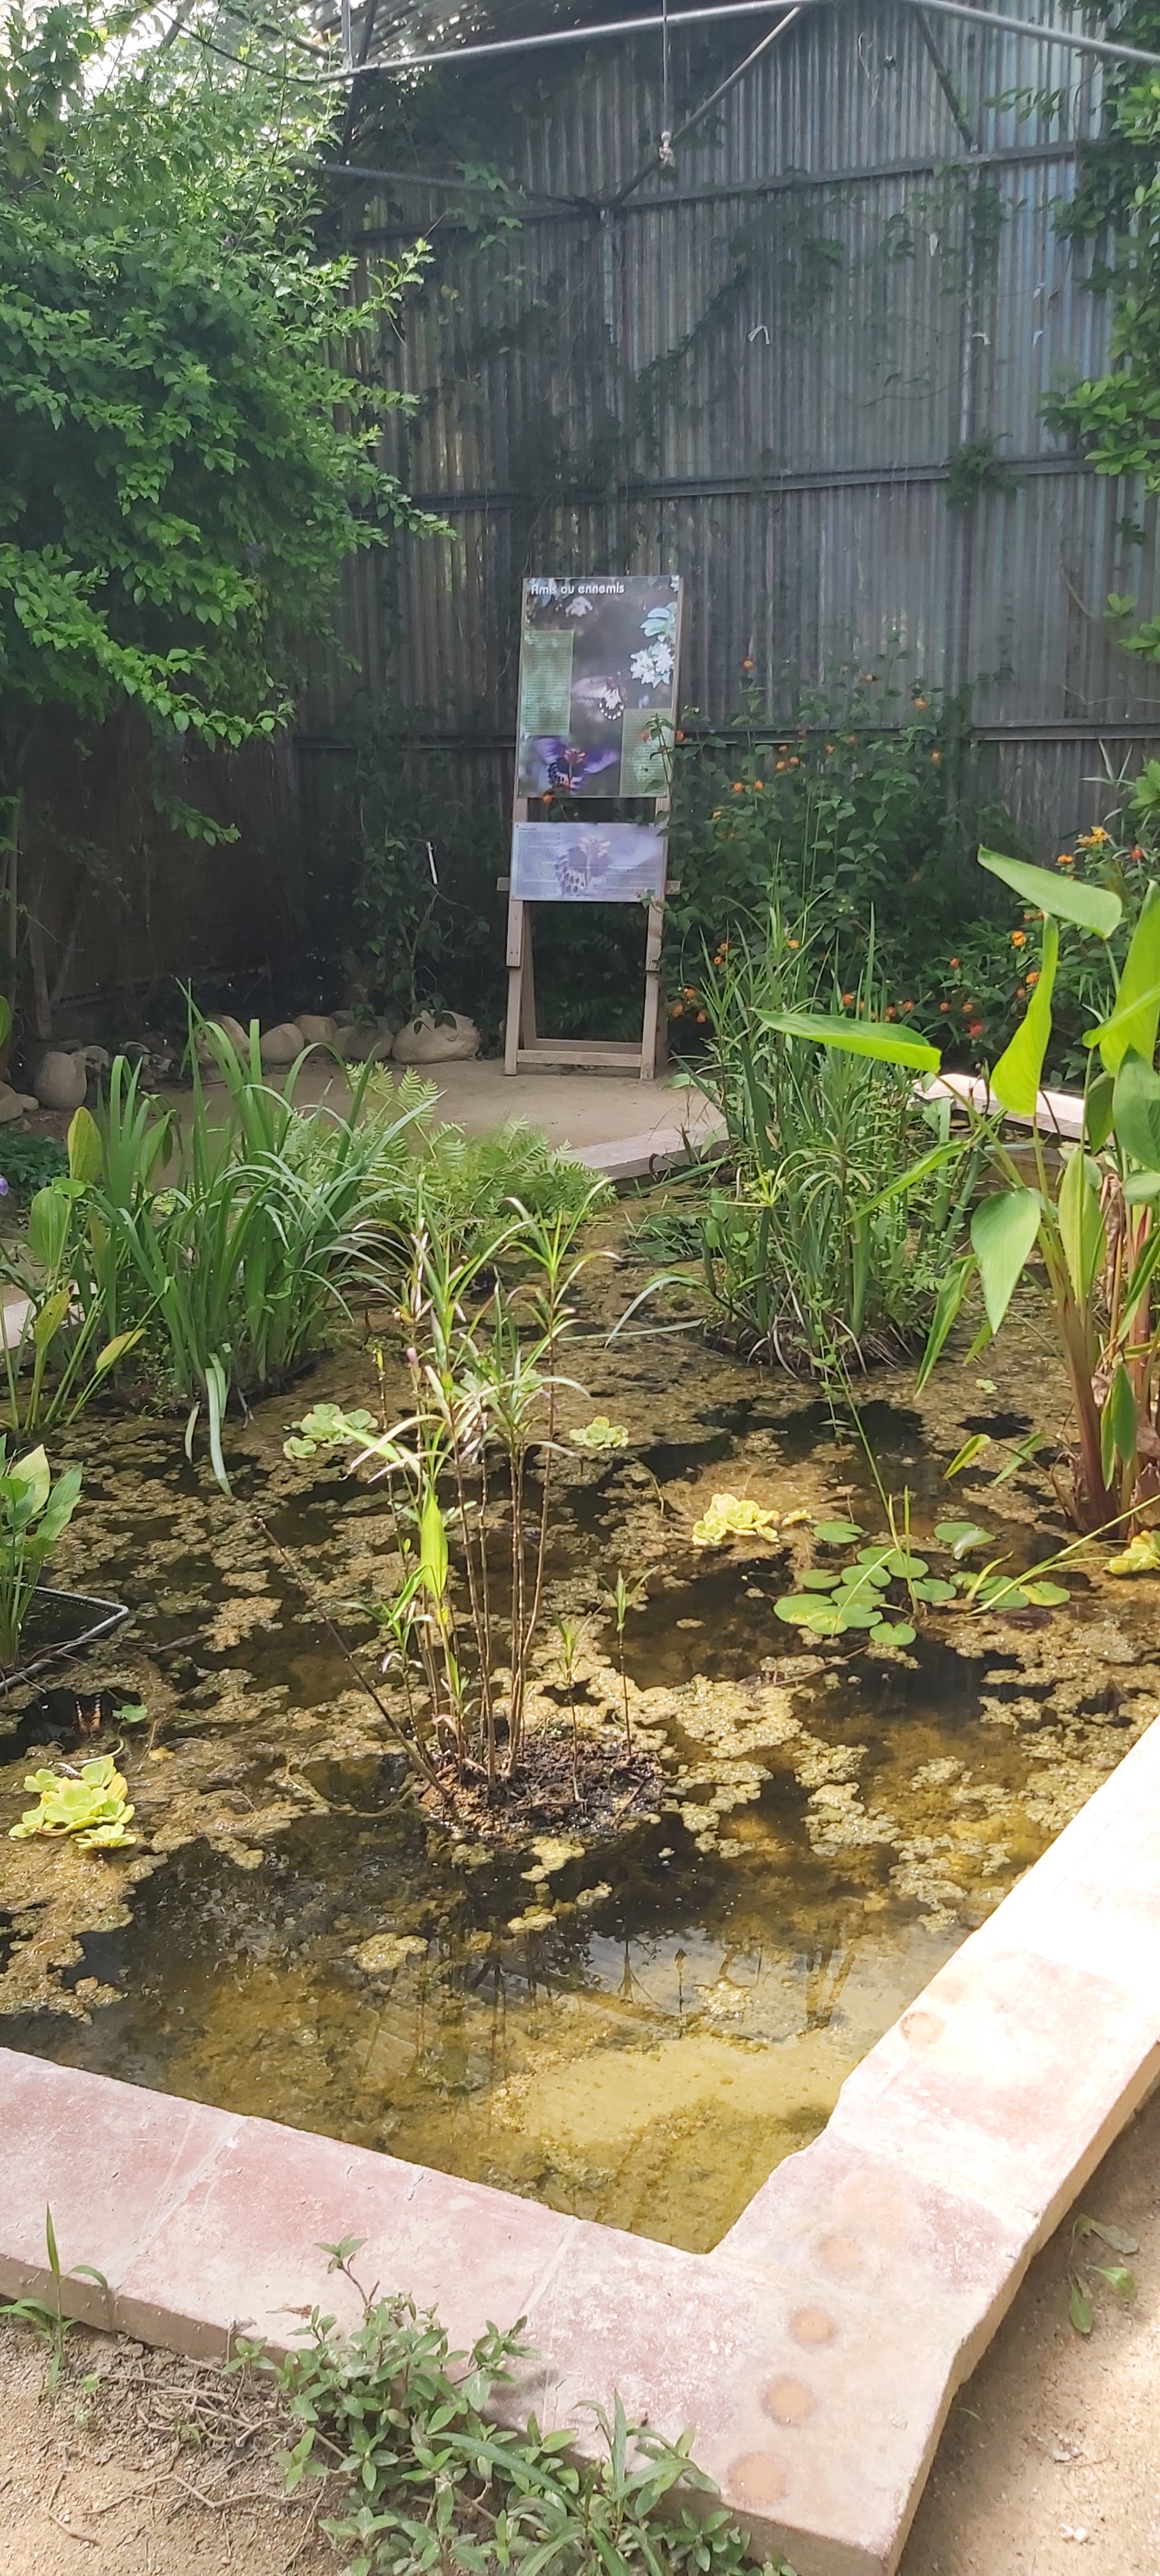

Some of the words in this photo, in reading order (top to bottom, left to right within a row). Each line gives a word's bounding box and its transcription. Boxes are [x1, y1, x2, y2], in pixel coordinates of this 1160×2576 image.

[531, 583, 558, 595] Amis
[560, 584, 575, 595] ou
[577, 581, 625, 595] ennemis
